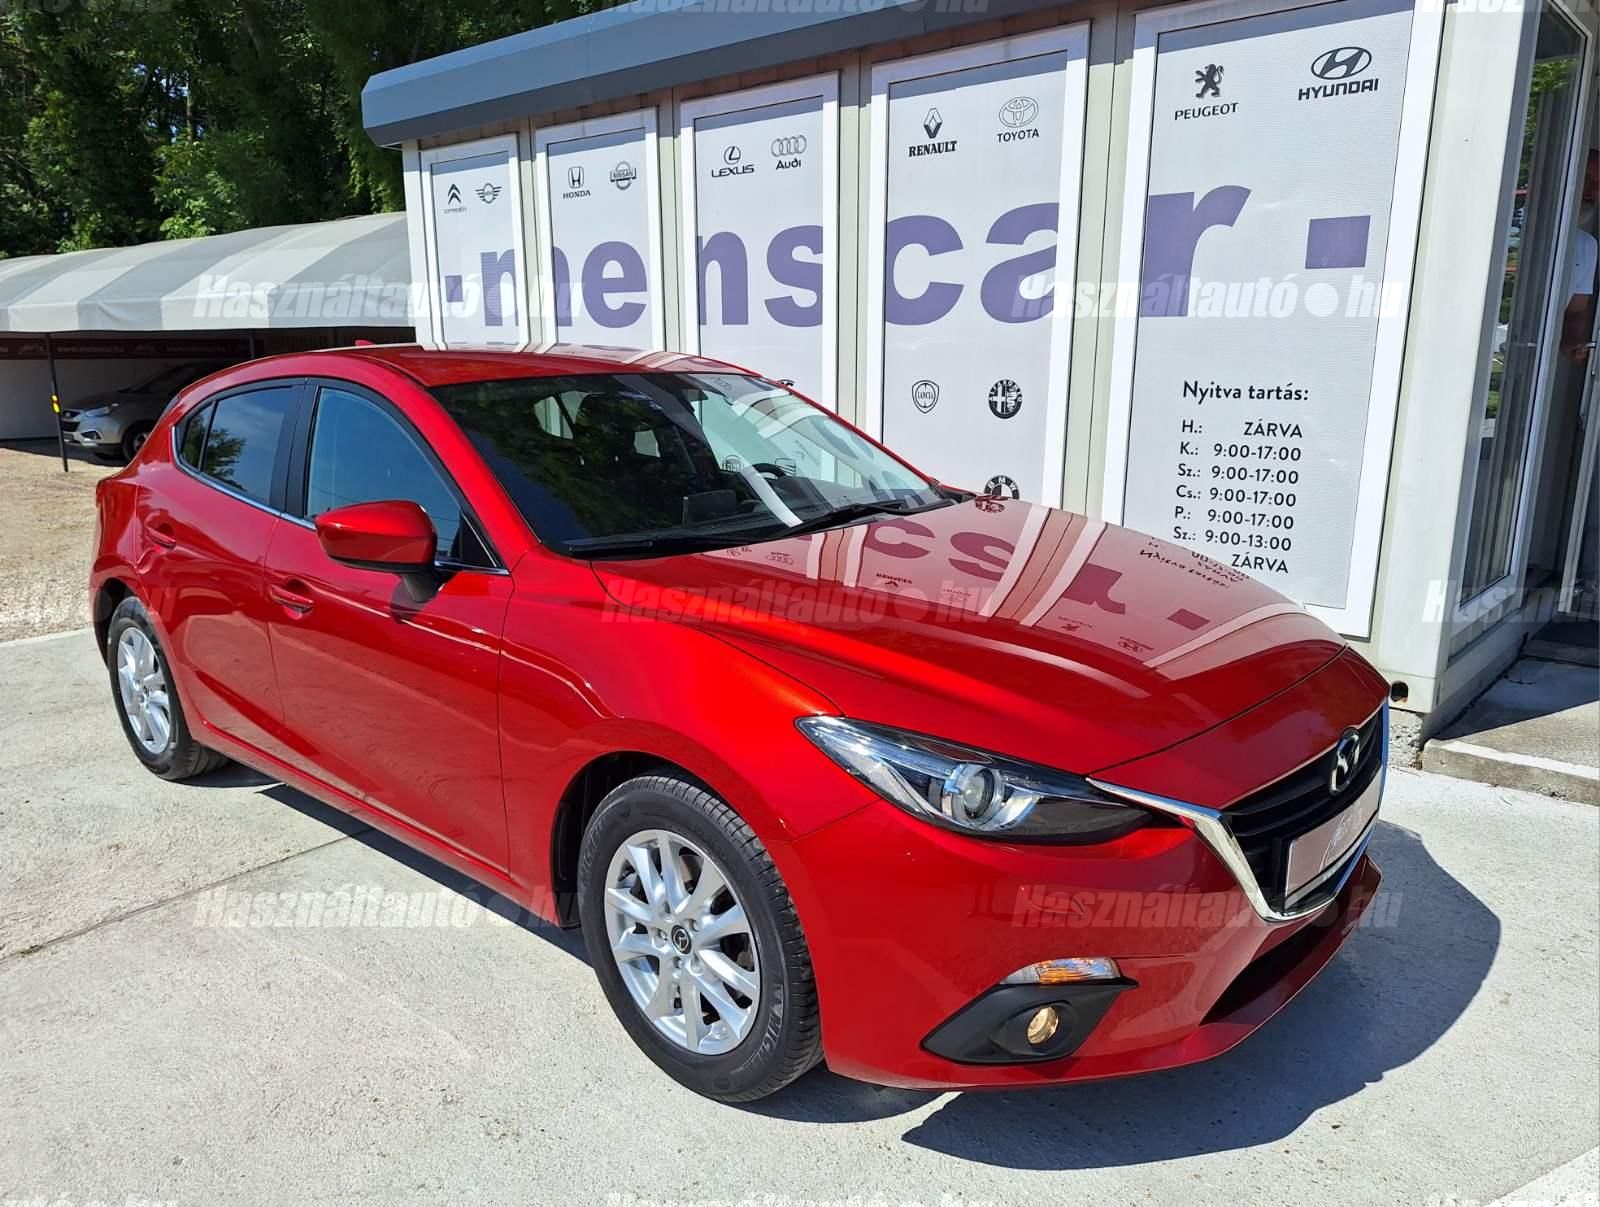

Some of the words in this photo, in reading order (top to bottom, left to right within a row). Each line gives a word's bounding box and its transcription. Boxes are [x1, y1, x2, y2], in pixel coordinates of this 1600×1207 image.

[1298, 78, 1379, 101] HYUNDAI
[1174, 102, 1239, 121] PEUGEOT
[997, 128, 1040, 143] TOYOTA
[908, 140, 958, 157] RENAULT
[711, 164, 755, 178] LEXUS
[775, 157, 802, 170] Audi
[612, 169, 635, 180] NISSAN
[562, 189, 591, 200] HONDA
[1182, 380, 1241, 405] Nyitva
[1248, 382, 1309, 401] tartás:
[1181, 419, 1203, 435] H.:
[1243, 418, 1303, 439] ZÁRVA
[1179, 441, 1199, 456] K.:
[1213, 443, 1302, 462] 9:00-17:00
[1177, 463, 1201, 478] Sz.:
[1211, 465, 1299, 485] 9:00-17:00
[1175, 484, 1201, 500] Cs.:
[1209, 487, 1297, 508] 9:00-17:00
[1174, 506, 1191, 521] P.:
[1207, 509, 1295, 530] 9:00-17:00
[1173, 526, 1197, 541] Sz.:
[1204, 529, 1292, 551] 9:00-13:00
[1231, 551, 1289, 574] ZÁRVA
